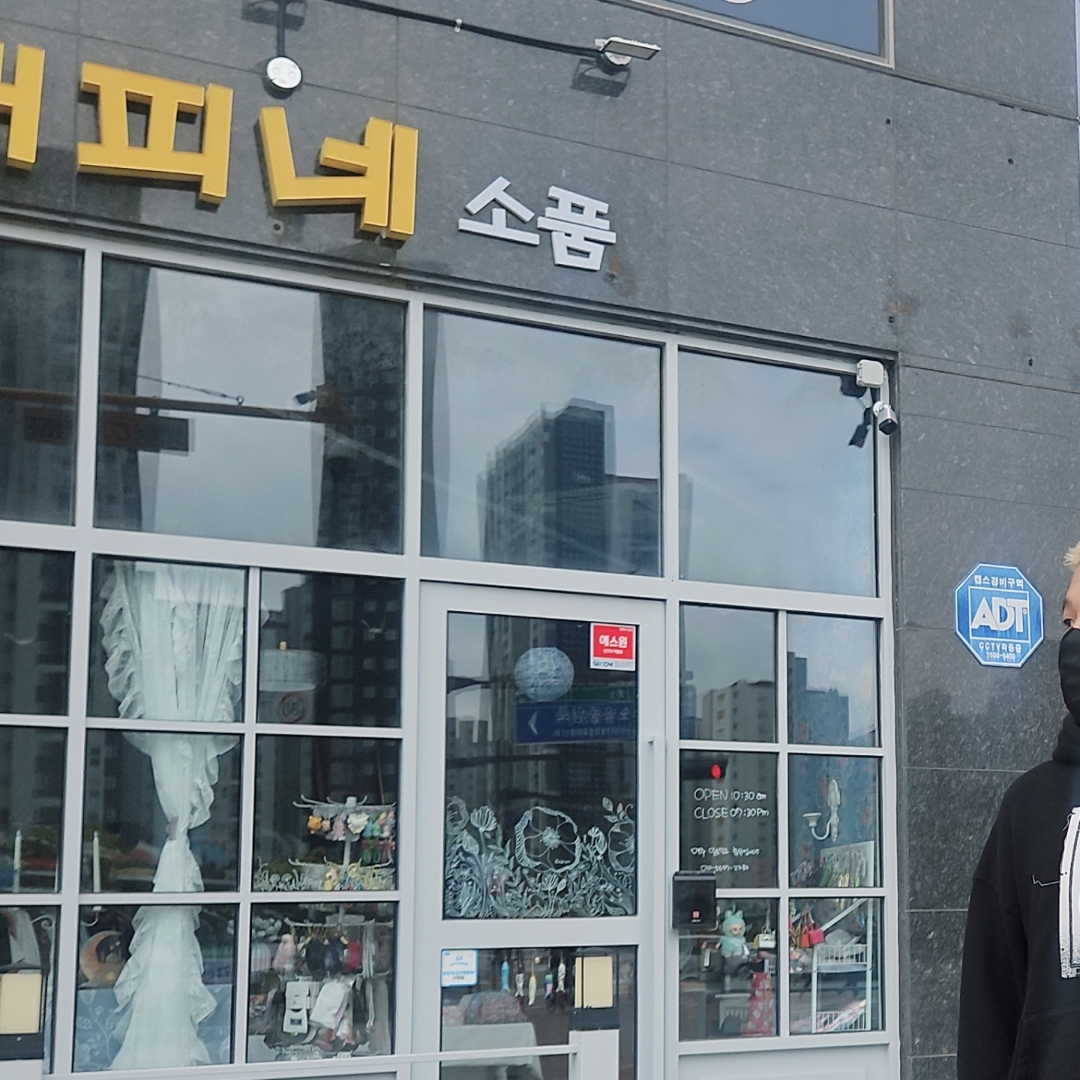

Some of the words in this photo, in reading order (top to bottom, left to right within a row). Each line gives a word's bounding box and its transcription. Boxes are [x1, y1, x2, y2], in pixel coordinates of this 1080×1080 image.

[458, 176, 617, 273] 소품
[970, 596, 1029, 632] ADT
[598, 634, 628, 649] 에스원
[693, 787, 728, 801] OPEN
[693, 807, 728, 820] CLOSE
